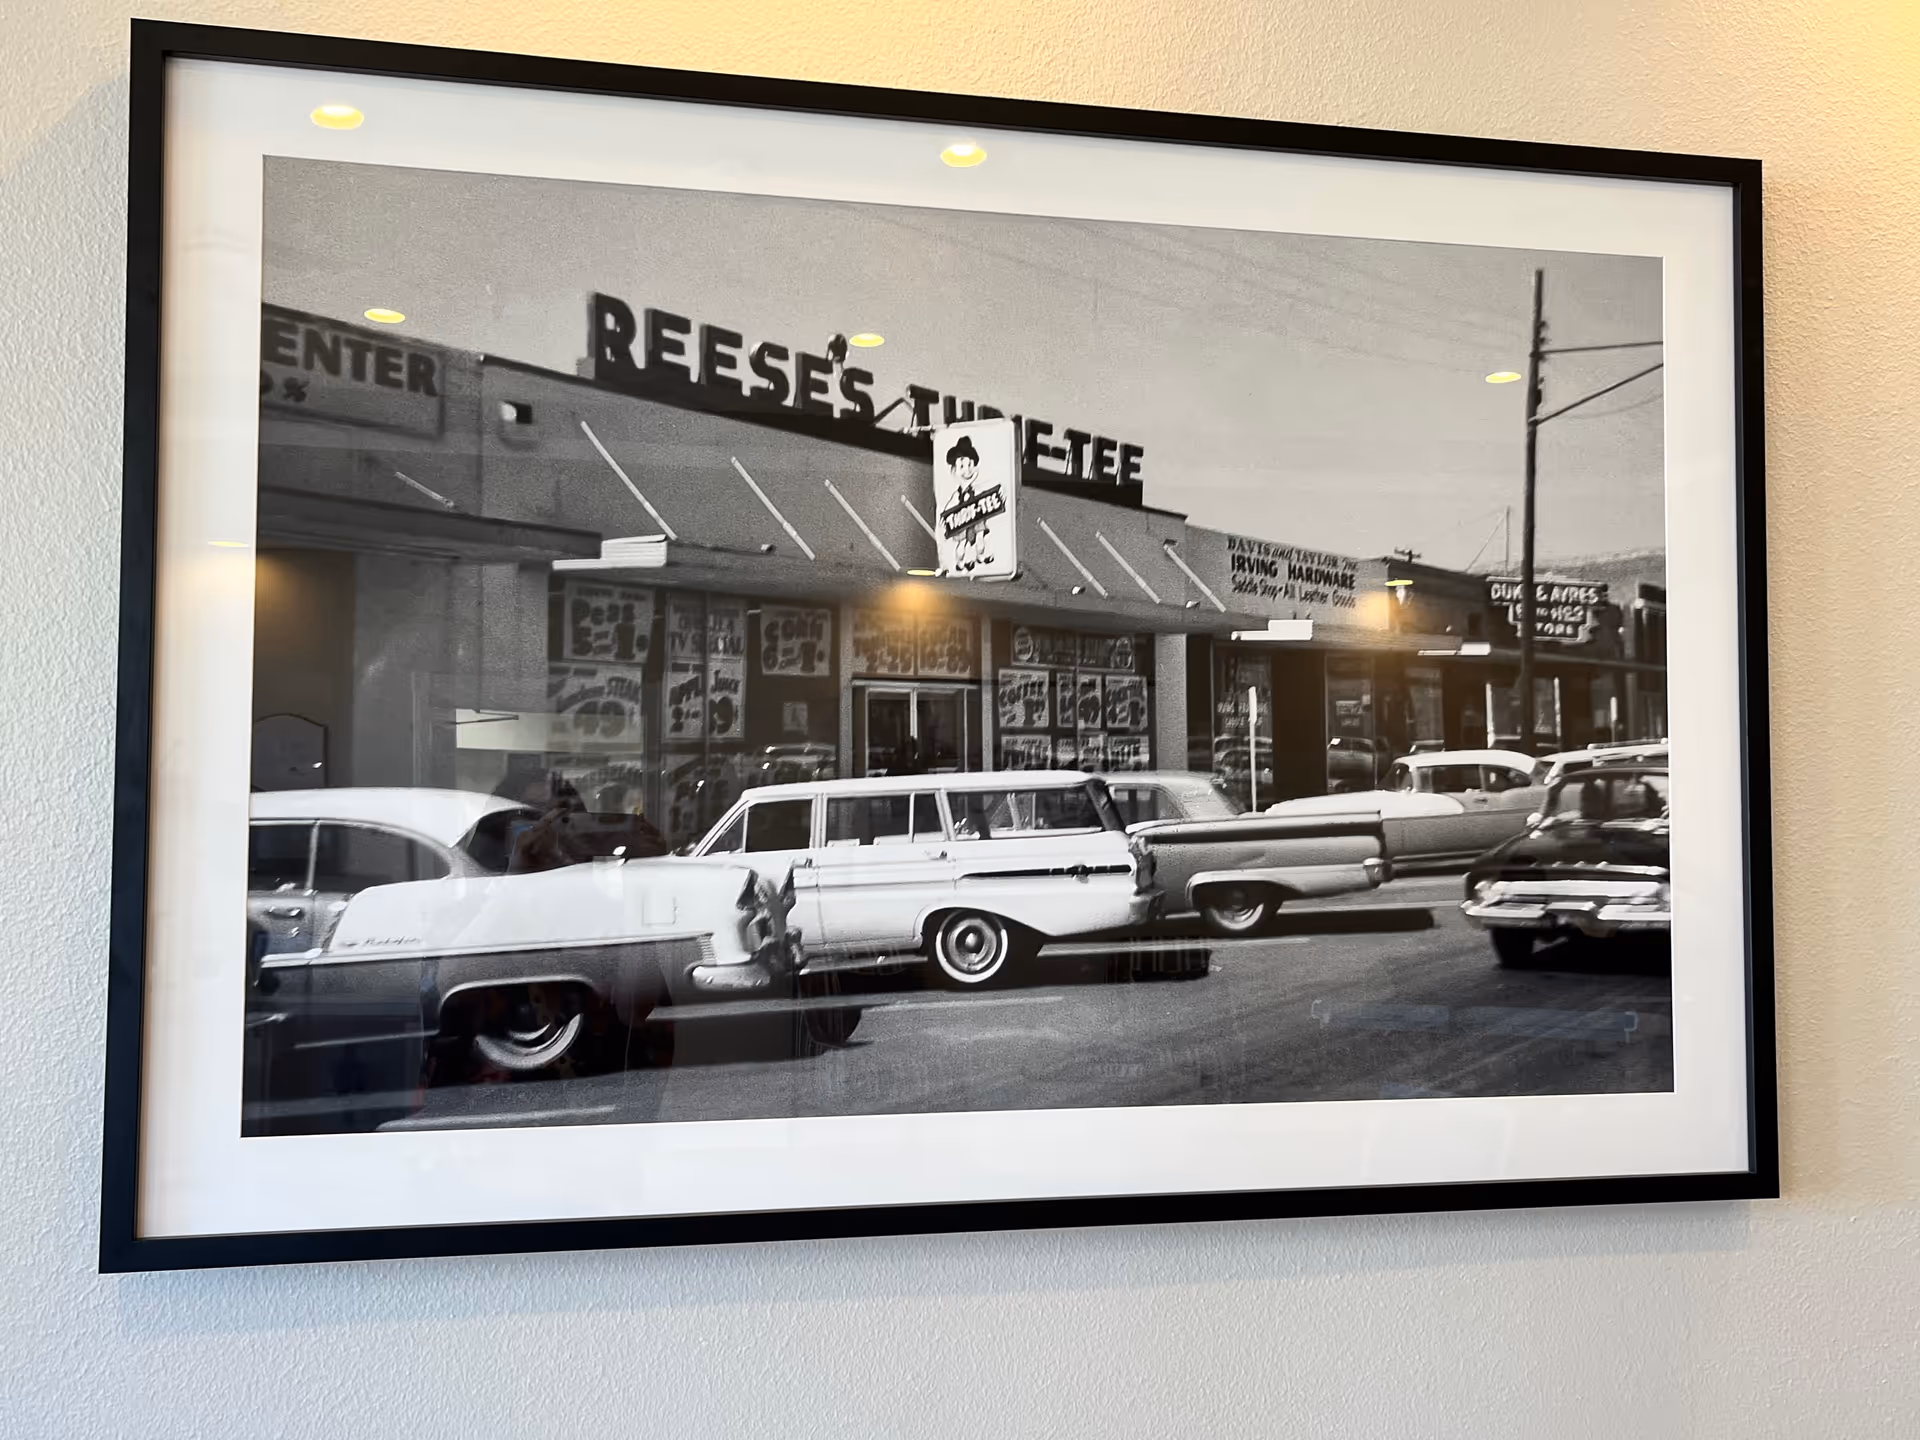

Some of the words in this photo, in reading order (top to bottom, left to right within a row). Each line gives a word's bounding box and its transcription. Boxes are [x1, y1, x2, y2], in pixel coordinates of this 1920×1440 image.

[586, 292, 876, 422] REESE'S
[906, 384, 1143, 484] THF-TEE
[1230, 553, 1278, 578] IRVING
[1287, 562, 1356, 590] HARDWARE
[1534, 621, 1574, 635] TORE
